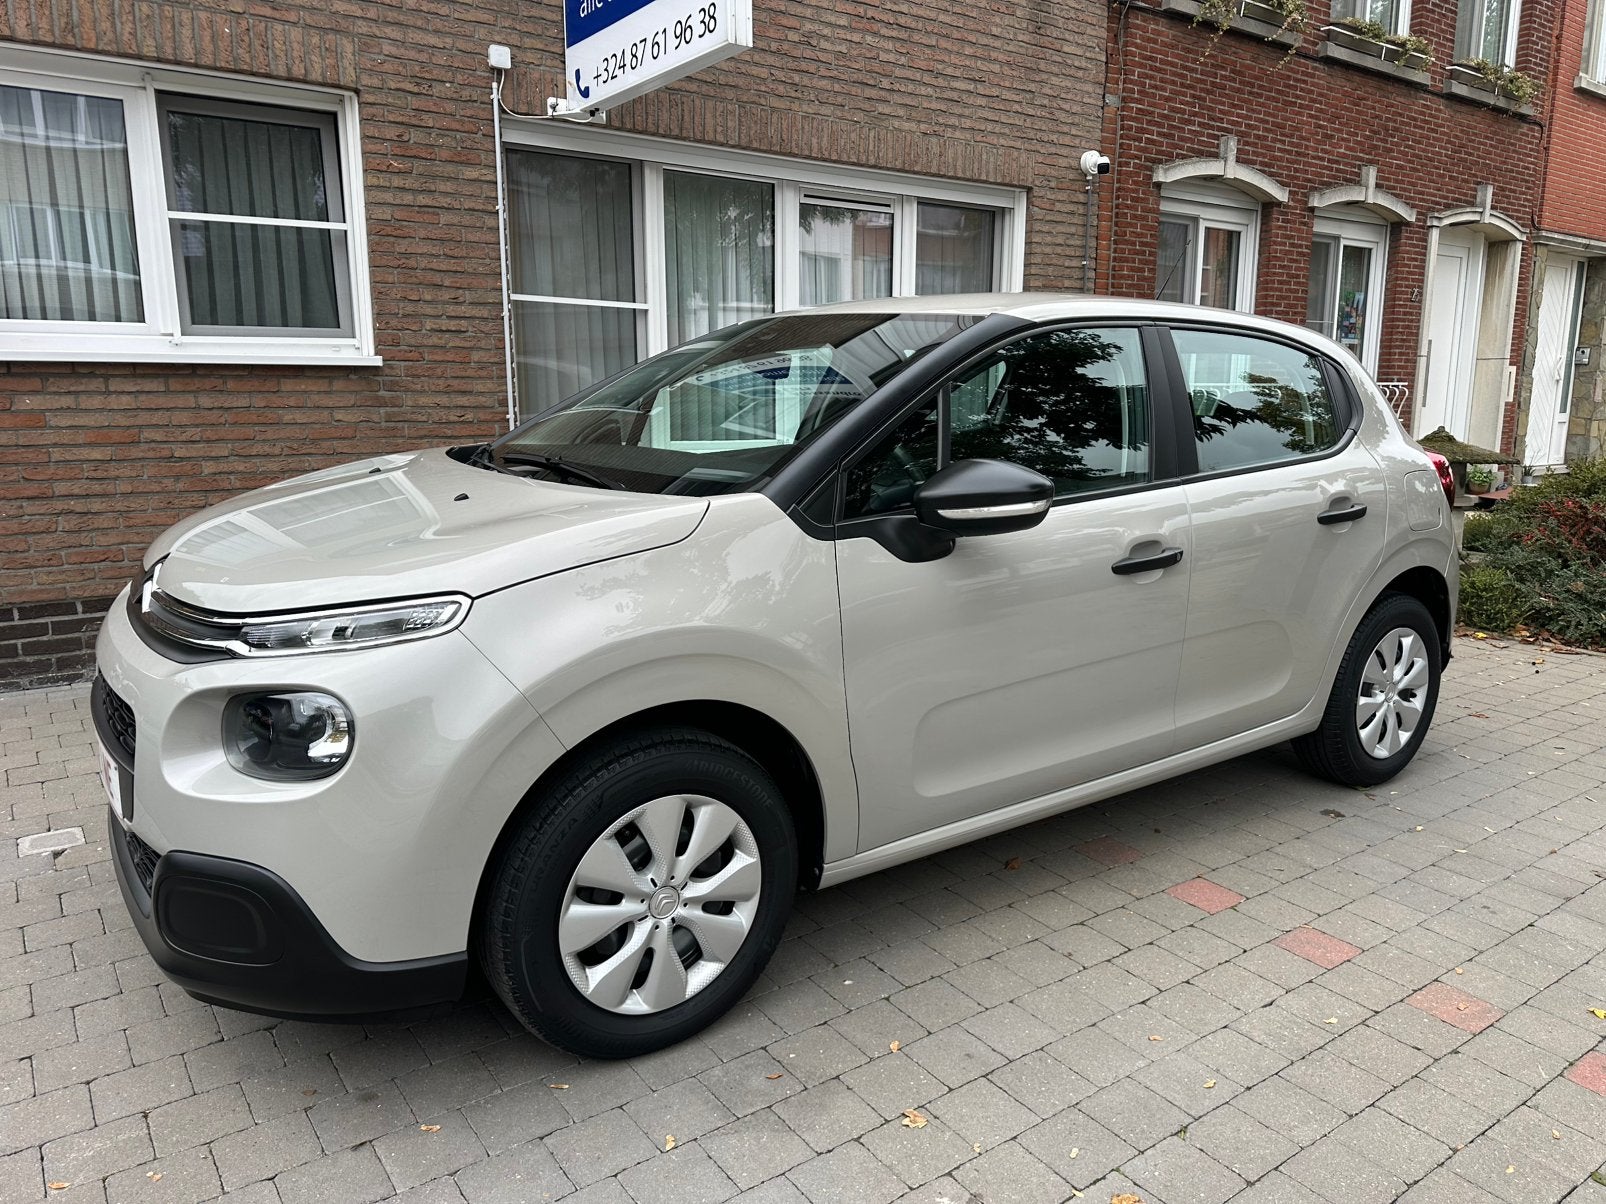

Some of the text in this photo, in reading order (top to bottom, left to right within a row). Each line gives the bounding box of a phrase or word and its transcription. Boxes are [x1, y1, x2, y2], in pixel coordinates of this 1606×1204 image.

[593, 2, 717, 87] +324 87 61 96 38
